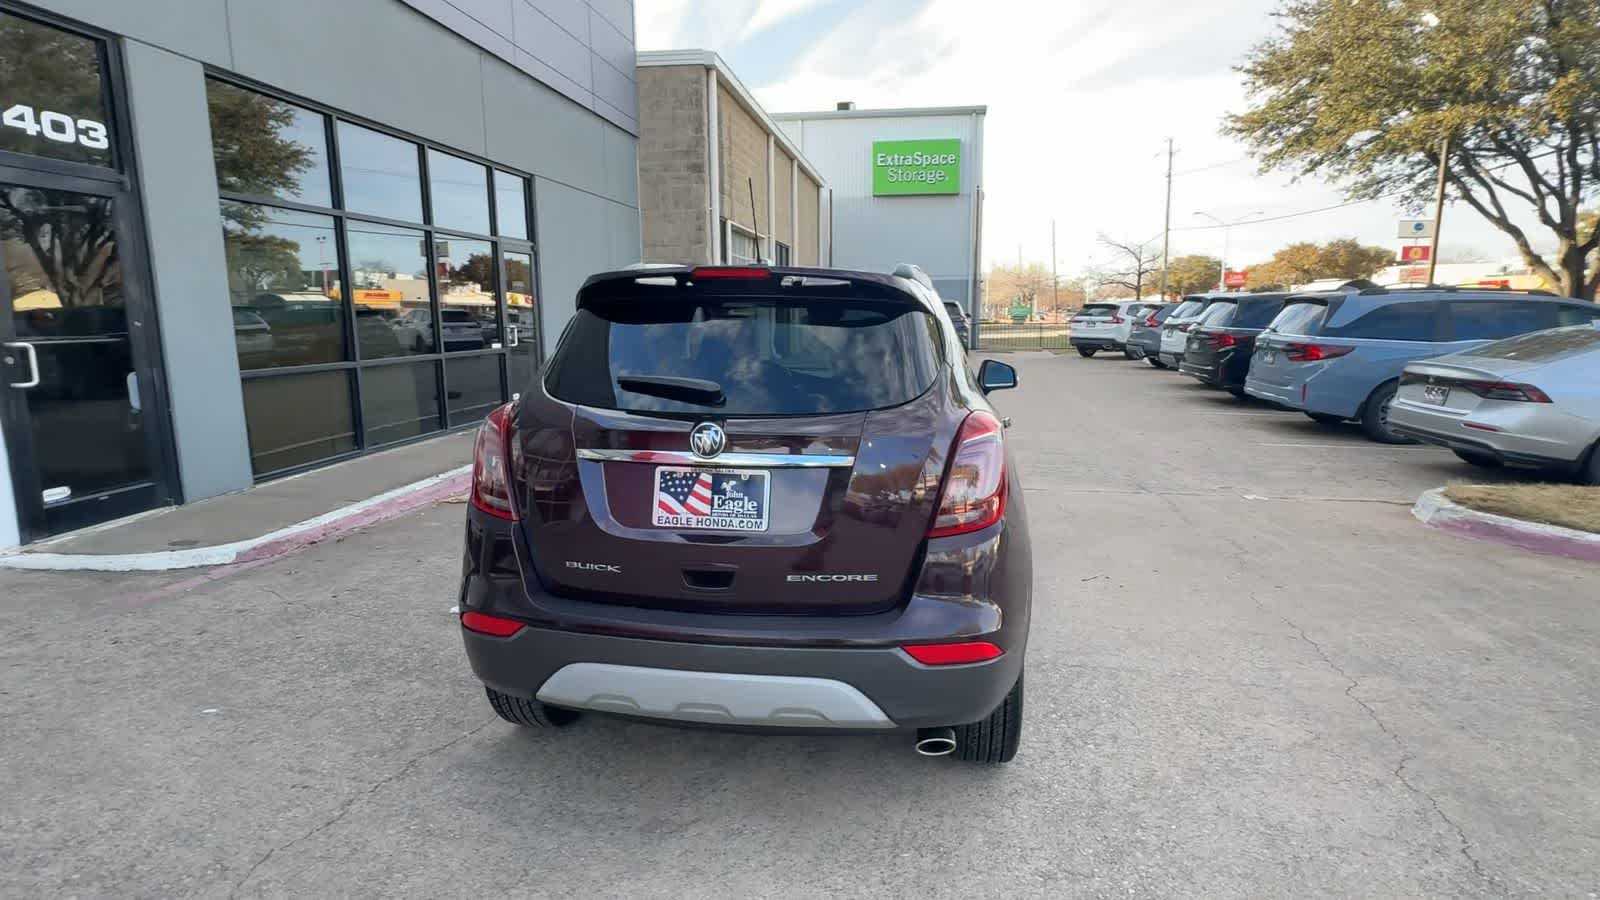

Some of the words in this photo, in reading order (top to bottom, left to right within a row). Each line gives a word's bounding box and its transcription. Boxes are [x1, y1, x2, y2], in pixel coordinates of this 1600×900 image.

[2, 104, 109, 149] 403
[877, 152, 956, 167] ExtraSpace
[726, 491, 743, 500] John
[712, 495, 758, 514] Eagle
[657, 515, 692, 526] EAGLE
[696, 517, 763, 529] HONDA.COM
[565, 560, 622, 573] BUICK
[786, 573, 878, 583] ENCORE
